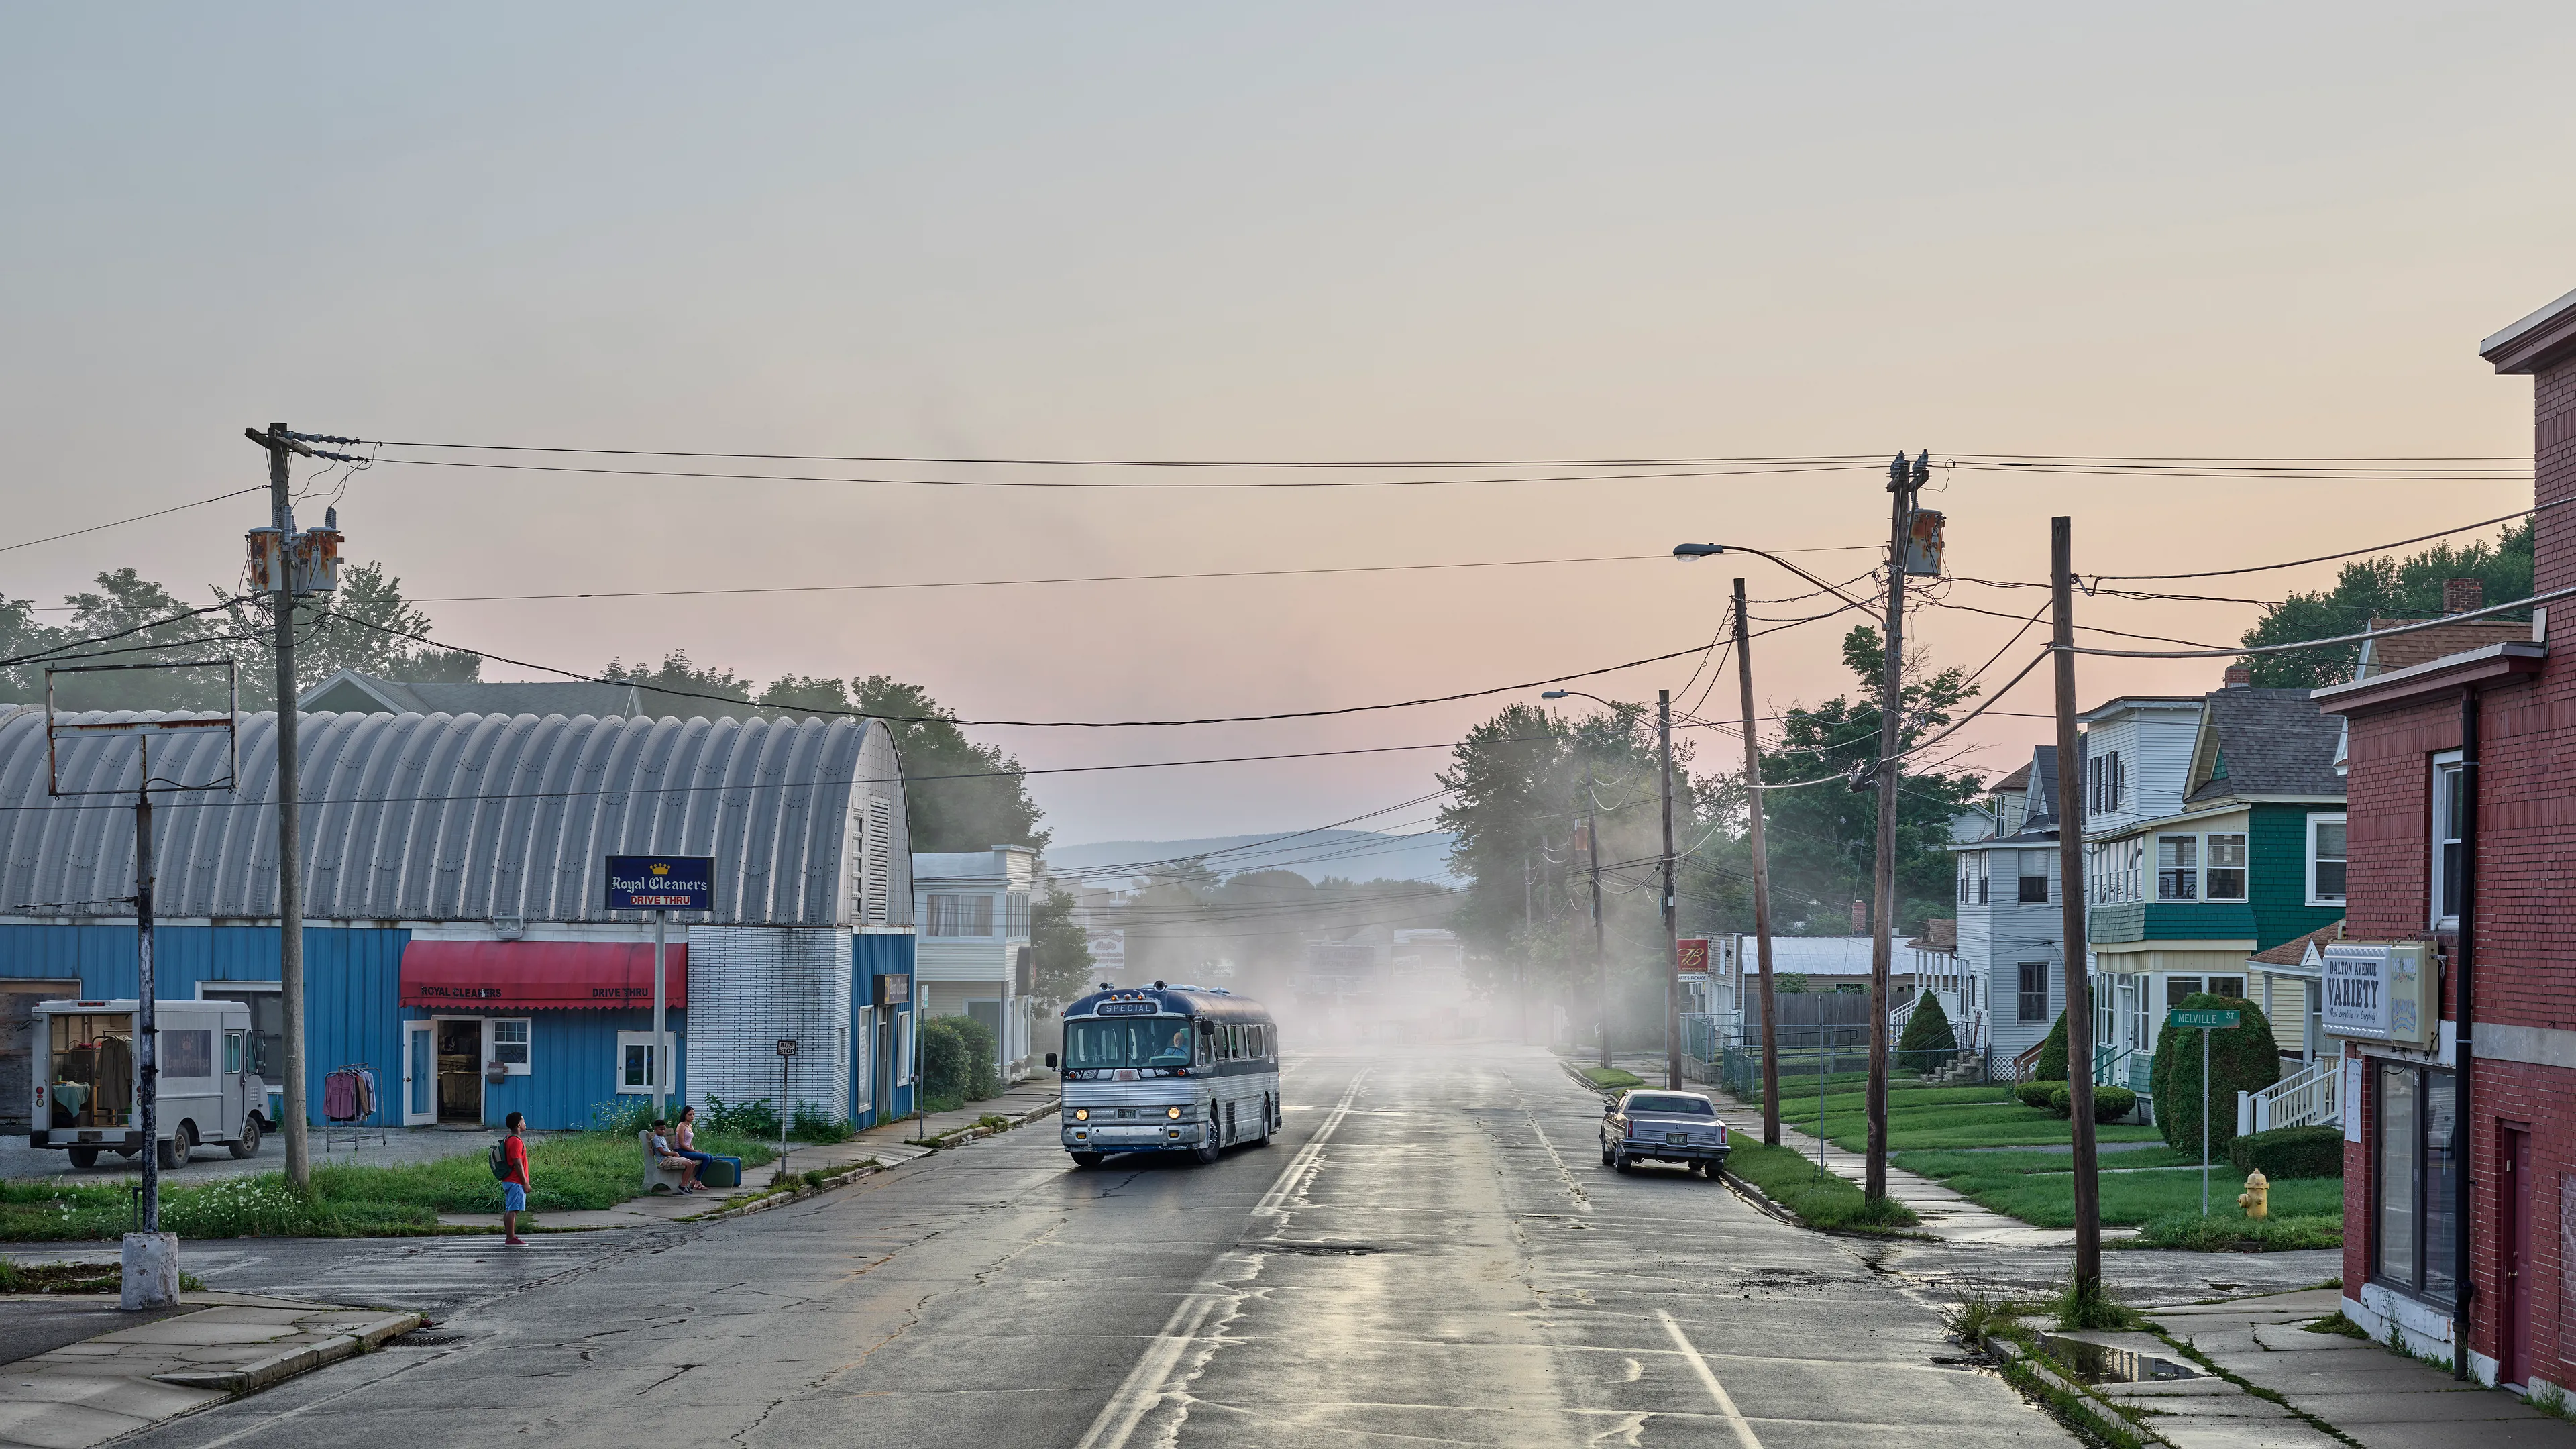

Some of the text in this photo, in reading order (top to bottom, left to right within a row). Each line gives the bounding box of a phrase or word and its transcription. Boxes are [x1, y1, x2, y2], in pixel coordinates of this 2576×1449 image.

[612, 876, 707, 894] Royal Cleaners
[631, 896, 690, 904] DRIVE THRU
[2330, 961, 2377, 977] DALTON AVENUE
[2392, 957, 2400, 973] THE
[421, 987, 502, 998] ROYAL CLEANERS
[592, 987, 648, 998] DRIVE THRU
[2327, 977, 2379, 1009] VARIETY
[1106, 1004, 1151, 1012] SPECIAL
[2178, 1012, 2235, 1024] MELVILLE ST
